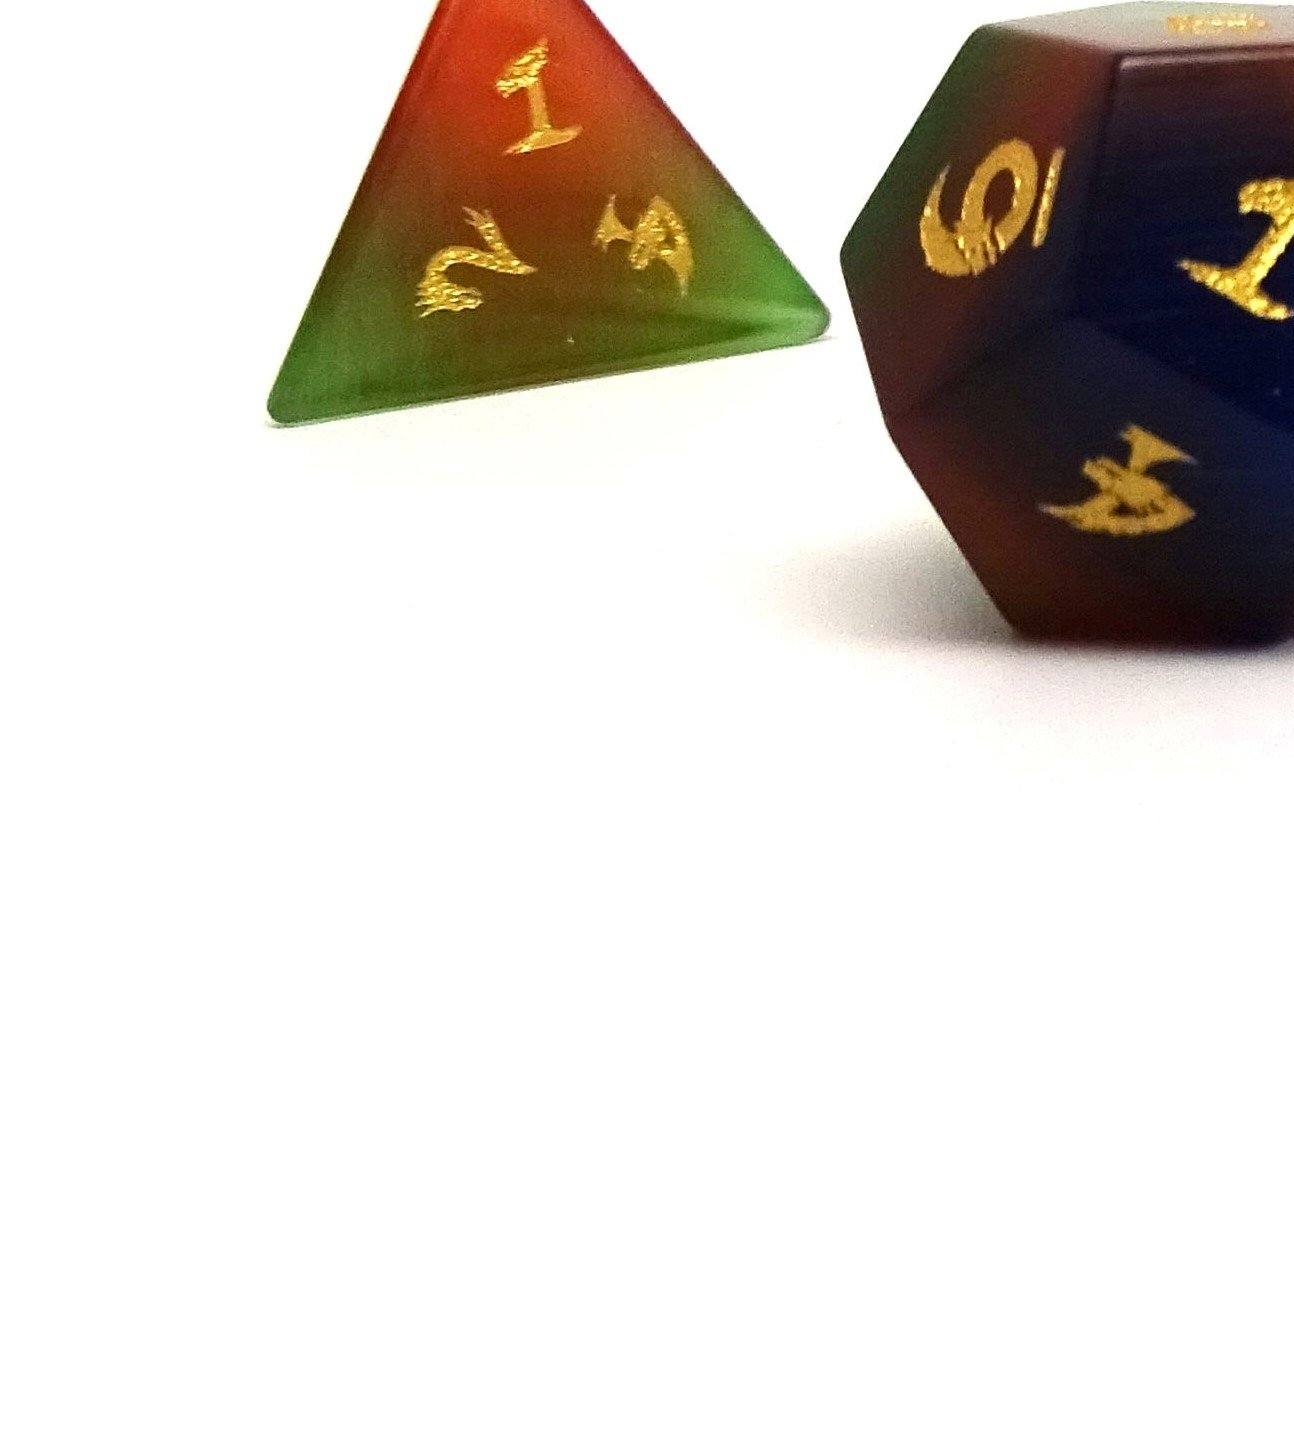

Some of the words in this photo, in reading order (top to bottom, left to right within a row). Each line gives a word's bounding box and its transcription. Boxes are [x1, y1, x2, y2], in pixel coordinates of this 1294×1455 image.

[495, 38, 583, 156] 1
[413, 205, 538, 318] 2
[593, 193, 695, 298] 4
[1037, 423, 1198, 538] 4
